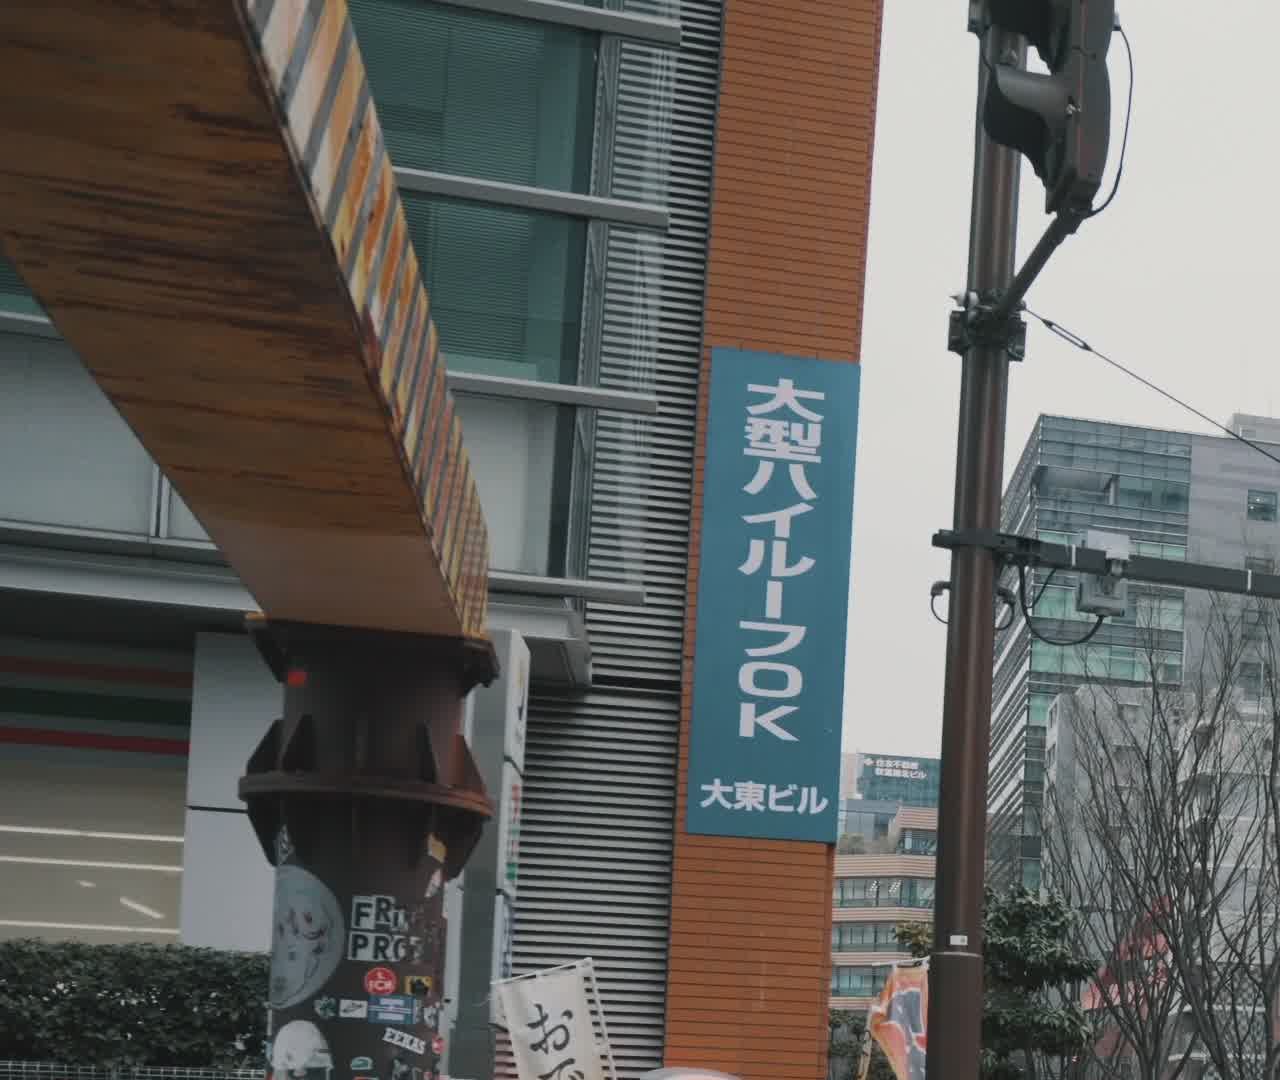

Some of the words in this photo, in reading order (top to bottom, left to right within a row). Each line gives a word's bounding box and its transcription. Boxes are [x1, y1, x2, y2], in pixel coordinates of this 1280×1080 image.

[737, 378, 825, 742] 大型ハイルーフOK
[699, 778, 829, 815] 大東ビル
